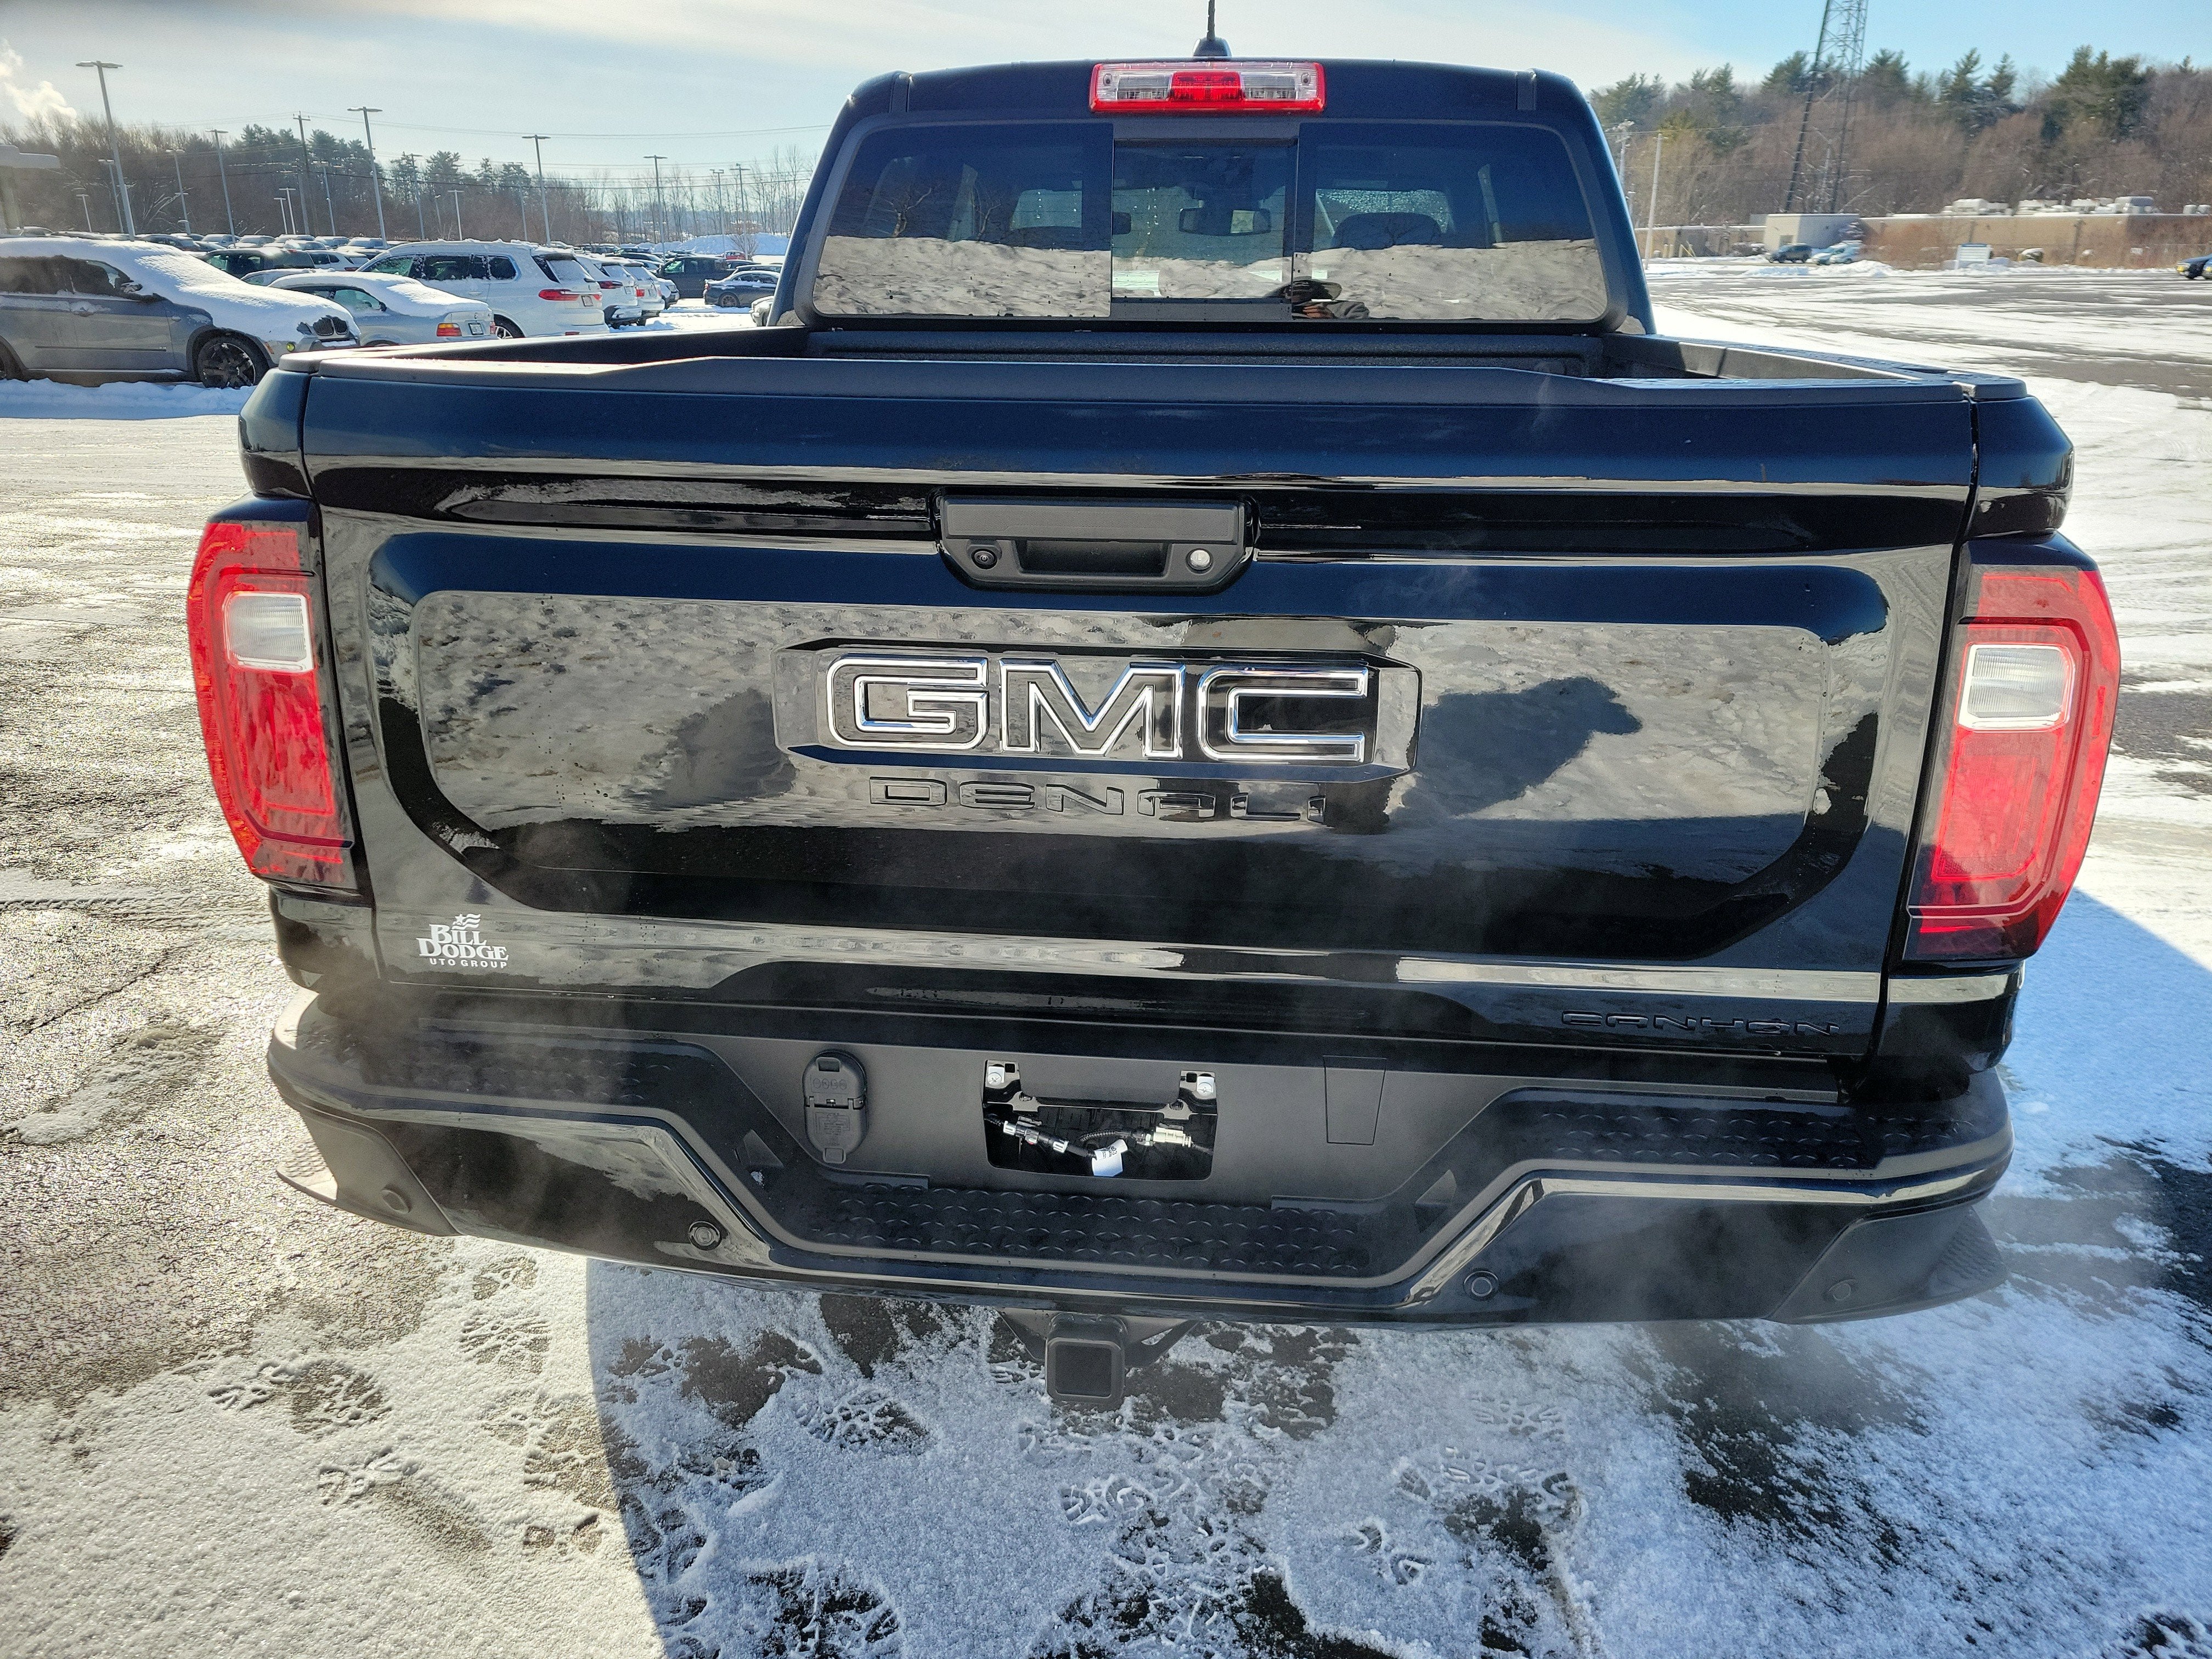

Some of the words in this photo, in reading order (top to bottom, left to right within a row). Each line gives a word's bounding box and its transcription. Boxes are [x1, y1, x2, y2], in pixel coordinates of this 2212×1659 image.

[826, 656, 1369, 763] GMC
[869, 776, 1326, 823] DENALI
[429, 924, 487, 945] BILL
[416, 938, 509, 961] DODGE
[460, 960, 507, 968] GROUP
[1561, 1010, 1839, 1036] CANYON
